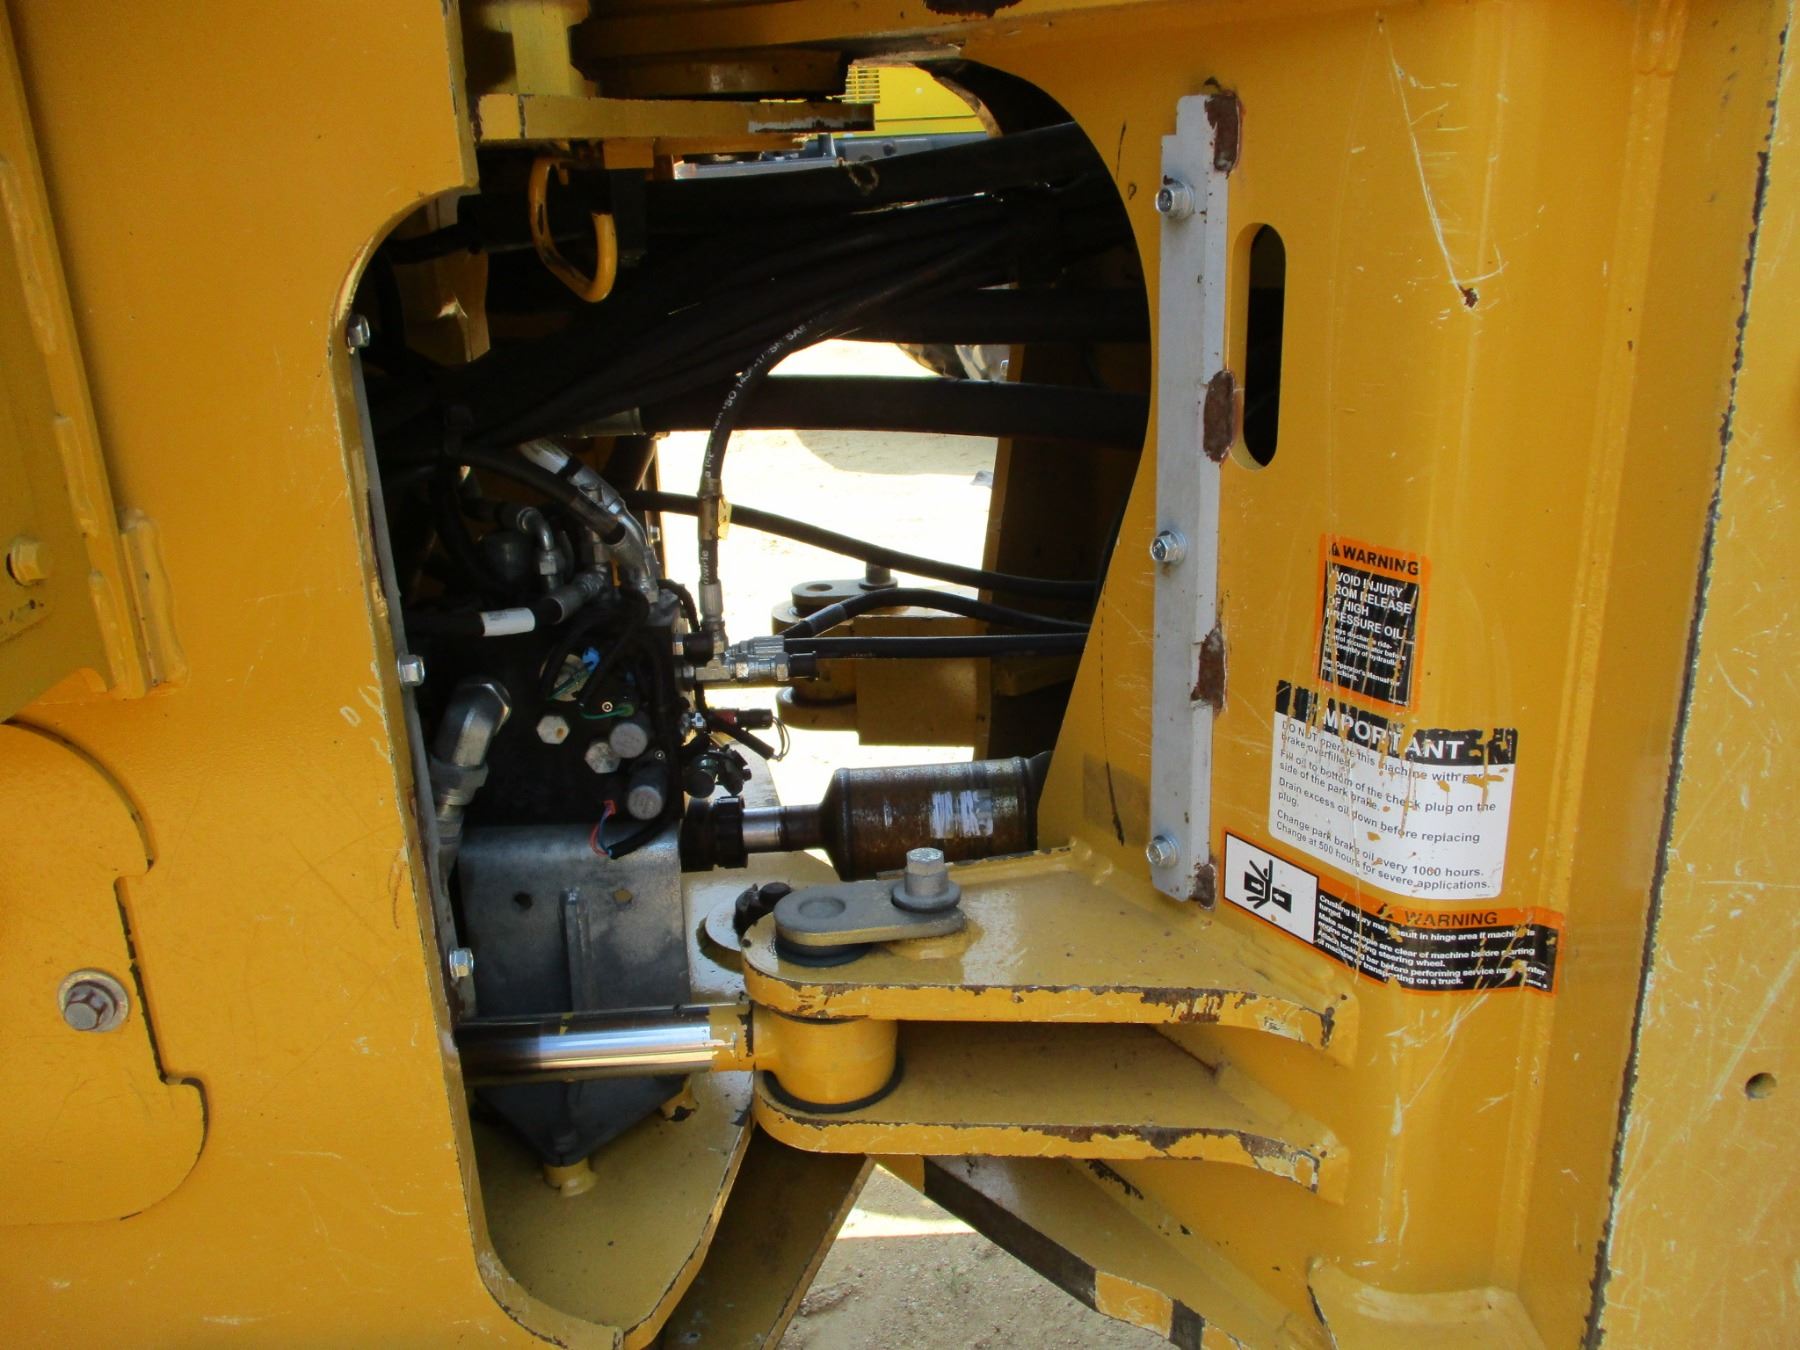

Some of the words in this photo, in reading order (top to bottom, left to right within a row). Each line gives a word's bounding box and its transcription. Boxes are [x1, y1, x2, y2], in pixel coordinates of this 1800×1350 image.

[1342, 544, 1419, 576] WARNING
[1331, 567, 1361, 587] VOID
[1363, 578, 1403, 598] INJURY
[1331, 582, 1358, 600] ROM
[1342, 600, 1369, 616] HIGH
[1384, 626, 1404, 640] OIL
[1369, 653, 1397, 666] hydrauli
[1318, 706, 1465, 760] MPORTANT
[1280, 762, 1298, 776] side
[1300, 772, 1310, 781] of
[1311, 775, 1326, 788] the
[1327, 782, 1350, 799] park
[1357, 751, 1376, 767] this
[1379, 761, 1428, 780] achne
[1432, 772, 1458, 782] with
[1309, 762, 1318, 772] to
[1320, 766, 1353, 788] bottom
[1355, 782, 1366, 792] of
[1367, 786, 1383, 800] the
[1425, 801, 1453, 815] plug
[1457, 804, 1473, 812] on
[1477, 802, 1497, 812] the
[1279, 776, 1302, 793] Drain
[1304, 788, 1335, 809] excess
[1337, 804, 1350, 816] oil
[1351, 810, 1378, 828] down
[1421, 832, 1481, 844] replacing
[1276, 820, 1307, 842] Change
[1308, 837, 1318, 848] at
[1318, 840, 1334, 855] 500
[1362, 861, 1376, 875] for
[1377, 870, 1414, 886] severe
[1416, 879, 1491, 892] applications.
[1277, 809, 1310, 831] Change
[1312, 826, 1332, 841] park
[1362, 851, 1375, 861] oil
[1413, 865, 1442, 877] 1000
[1445, 867, 1485, 878] hours.
[1336, 922, 1353, 936] sure
[1379, 942, 1393, 952] are
[1394, 947, 1418, 958] clear
[1419, 951, 1430, 959] of
[1430, 949, 1470, 960] machine
[1373, 921, 1388, 934] may
[1392, 929, 1418, 940] esult
[1420, 932, 1429, 940] in
[1430, 933, 1457, 943] hinge
[1457, 931, 1478, 941] area
[1487, 929, 1525, 939] machi
[1526, 929, 1536, 937] is
[1366, 954, 1380, 966] bar
[1380, 960, 1409, 974] before
[1410, 968, 1461, 979] performing
[1378, 951, 1414, 967] steering
[1415, 959, 1446, 968] wheel.
[1415, 977, 1429, 985] on
